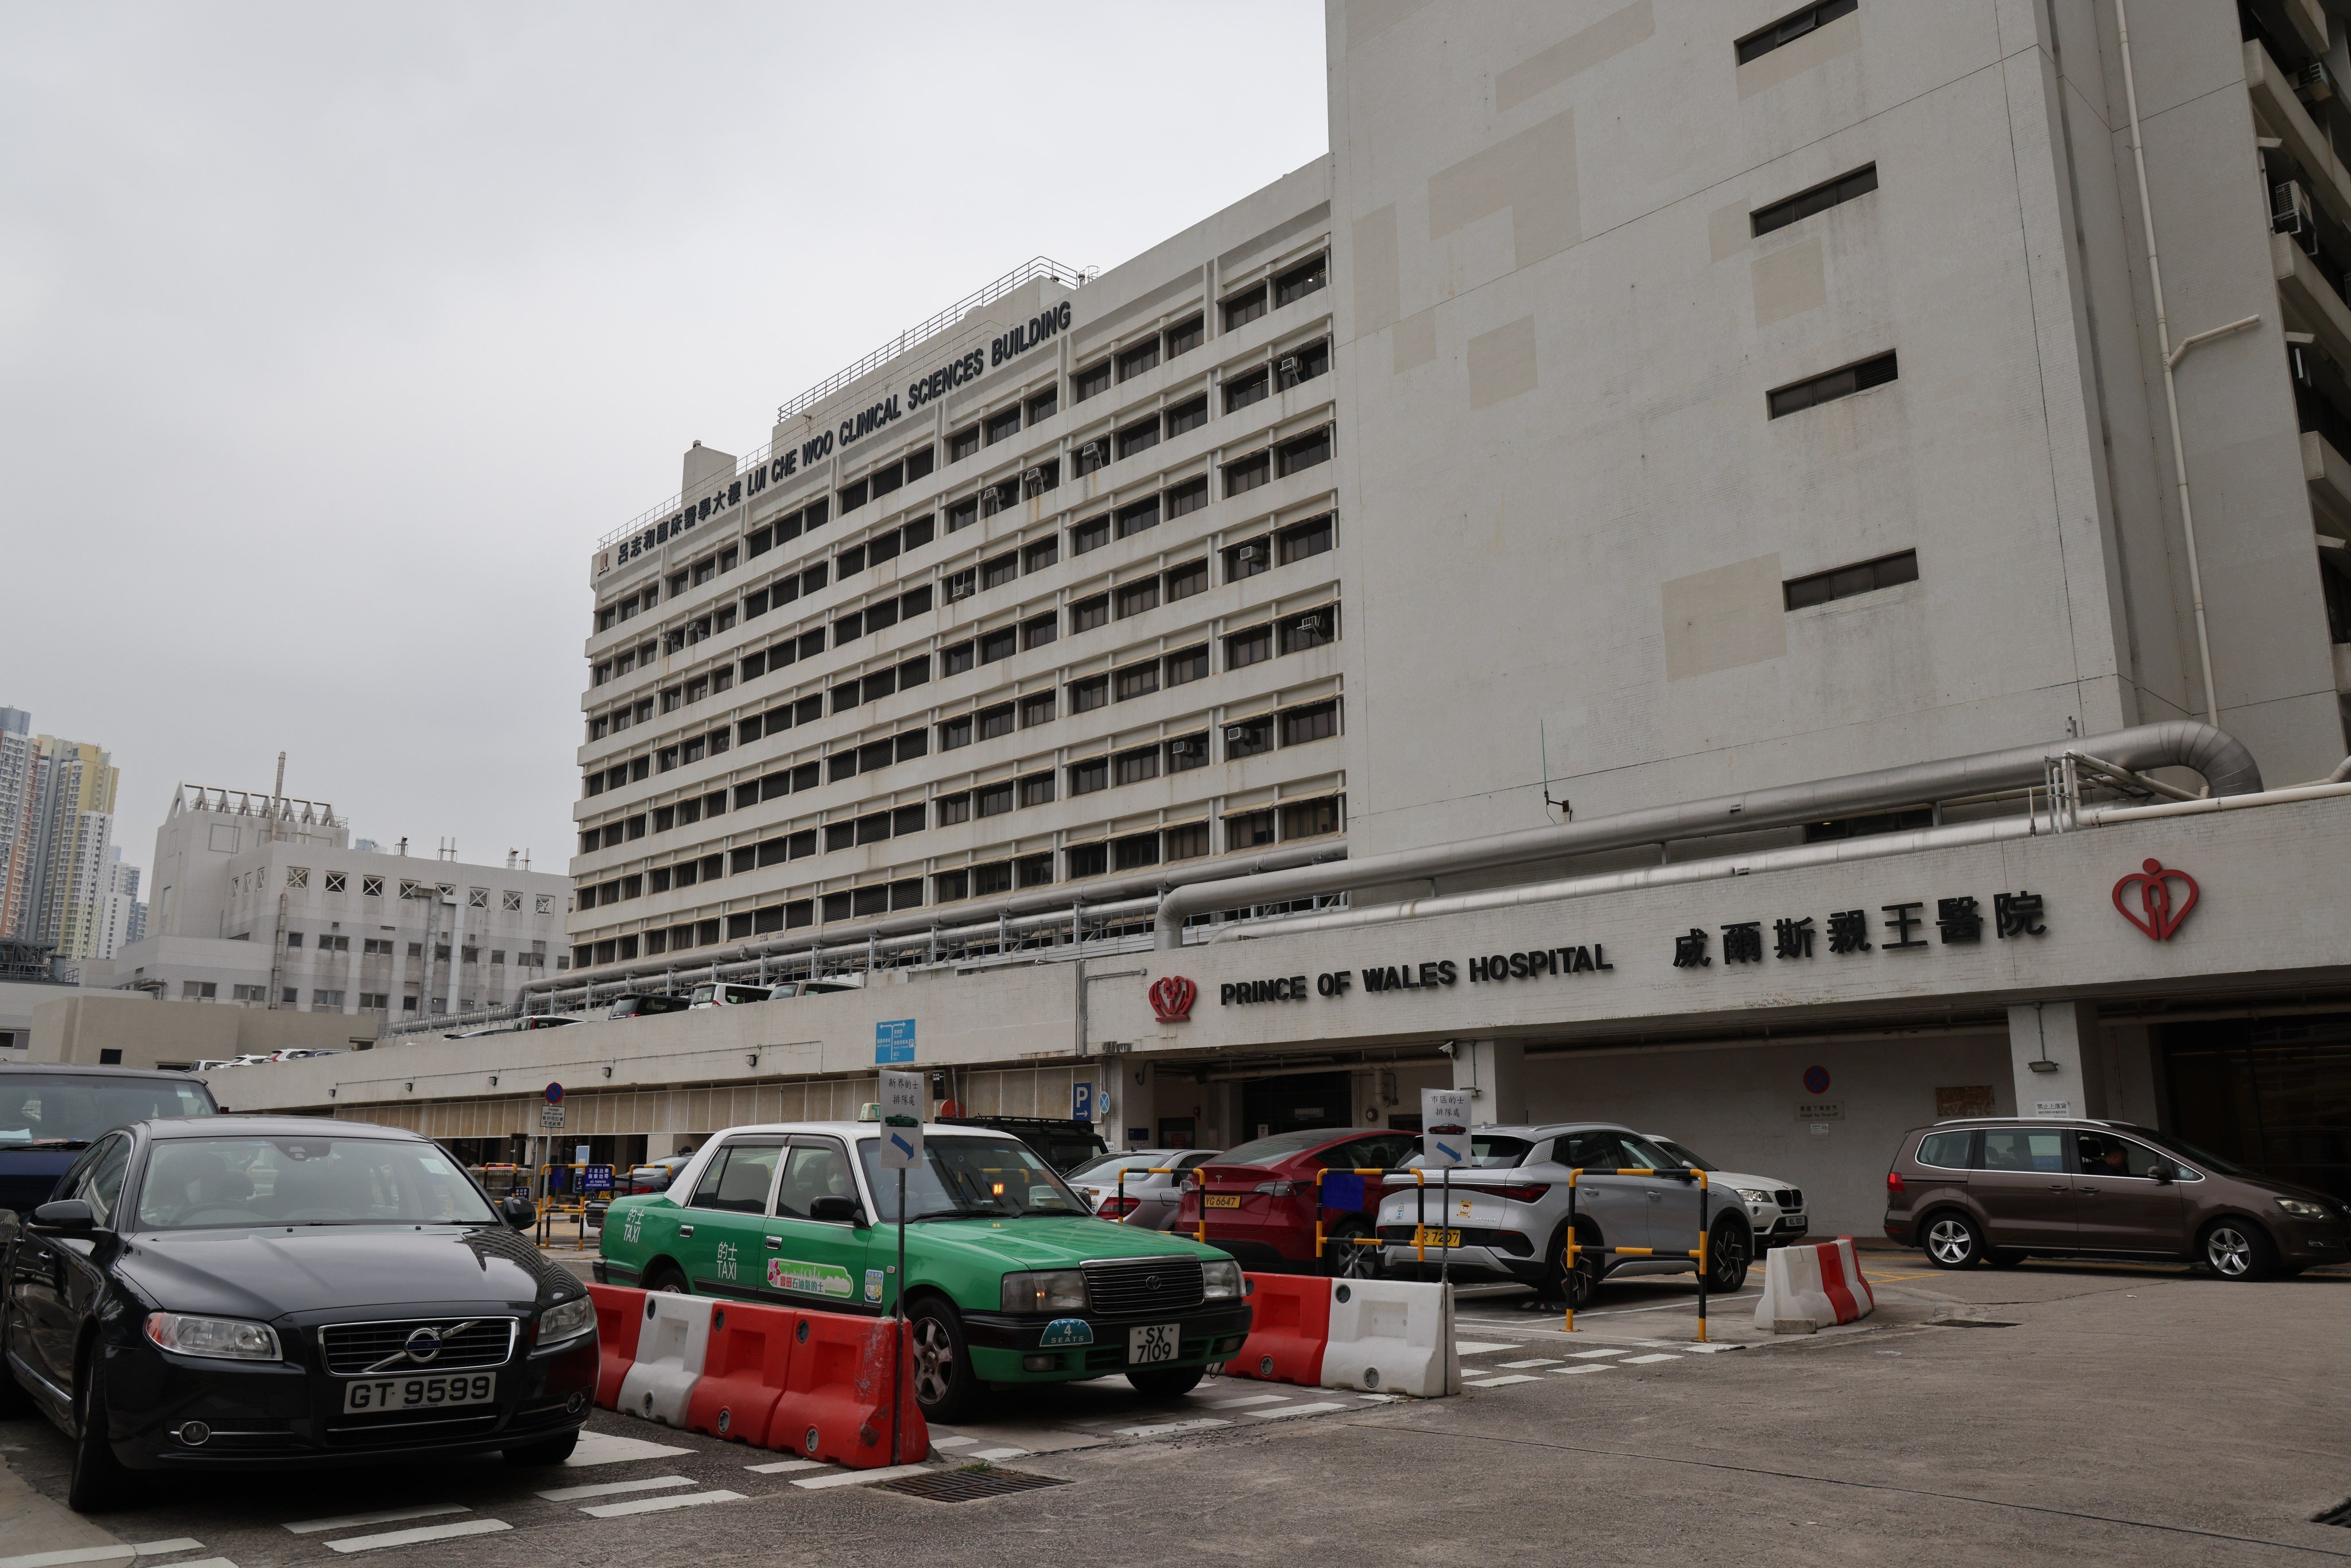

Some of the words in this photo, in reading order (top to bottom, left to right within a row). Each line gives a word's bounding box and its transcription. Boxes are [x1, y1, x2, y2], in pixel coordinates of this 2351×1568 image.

[747, 465, 766, 496] LUI
[771, 449, 797, 483] CHE
[802, 430, 833, 467] WOO
[839, 394, 902, 447] CLINICAL
[907, 348, 984, 410] SCIENCES
[991, 301, 1071, 367] BUILDING
[618, 480, 742, 565] 呂志和臨床醫學大樓
[1673, 890, 2047, 968] 威爾斯親王醫院
[1221, 976, 1307, 1006] PRINCE
[1317, 971, 1351, 996] OF
[1361, 960, 1456, 992] WALES
[1469, 944, 1613, 982] HOSPITAL
[889, 1078, 918, 1089] 新界的士
[893, 1095, 915, 1106] 排隊處
[1076, 1086, 1088, 1108] P
[1431, 1096, 1464, 1104] 市區的士
[1436, 1108, 1460, 1117] 排隊處
[1206, 1197, 1215, 1205] YG
[1216, 1197, 1236, 1206] 6647
[627, 1207, 644, 1225] 的士
[623, 1224, 641, 1243] TAXI
[717, 1241, 738, 1261] 的士
[717, 1260, 736, 1280] TAXI
[780, 1276, 824, 1293] 豐田石油氣的士
[1064, 1324, 1072, 1336] 4
[1145, 1326, 1165, 1344] SX
[1137, 1342, 1171, 1363] 7109
[350, 1382, 394, 1408] GT
[404, 1376, 490, 1404] 9599
